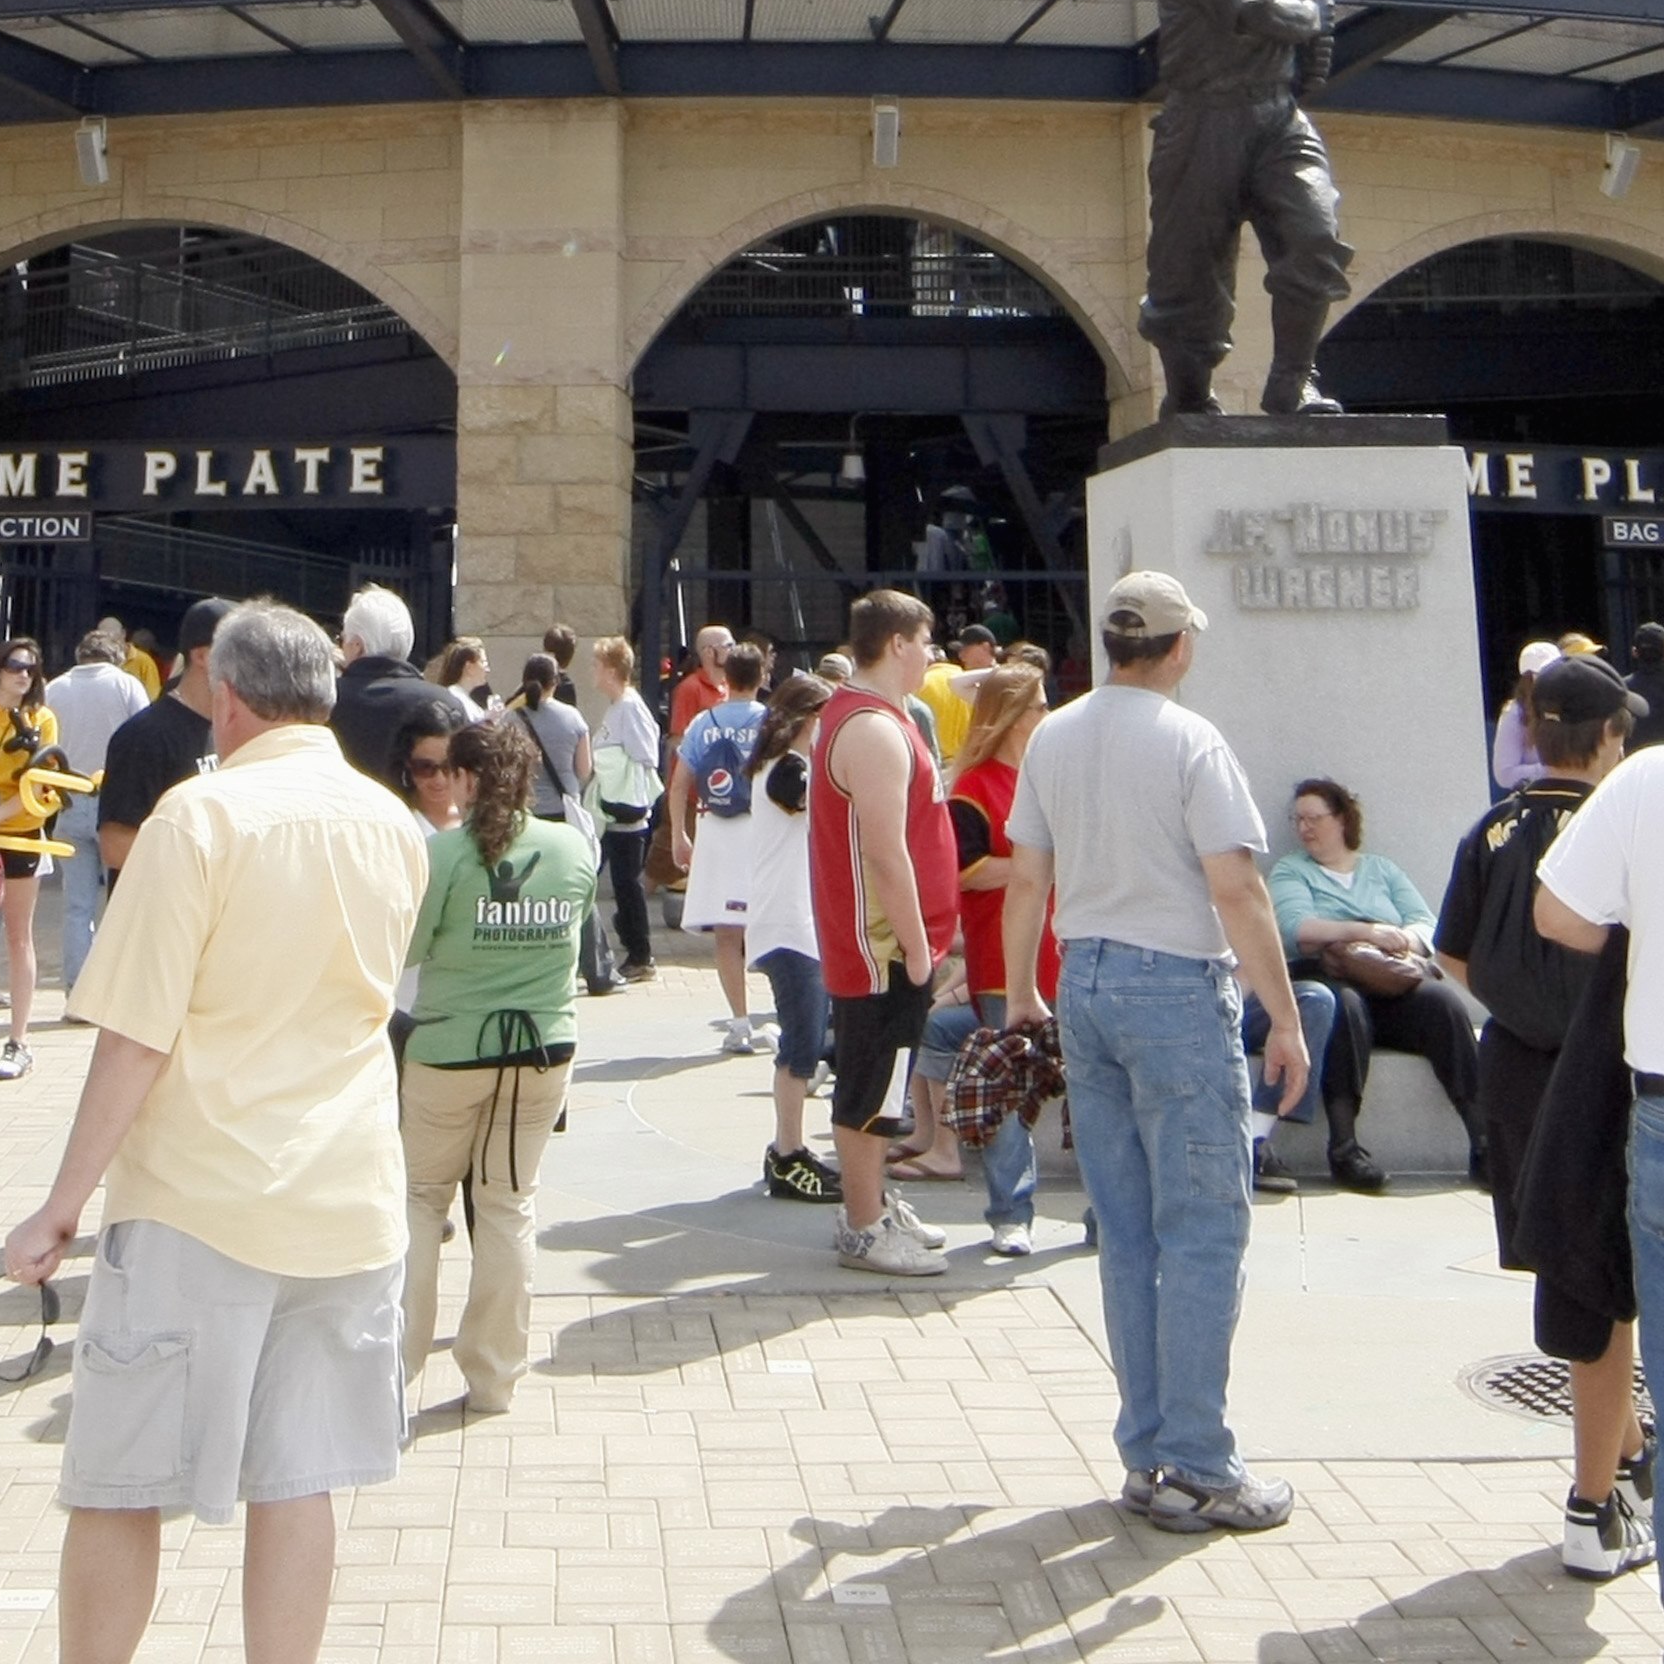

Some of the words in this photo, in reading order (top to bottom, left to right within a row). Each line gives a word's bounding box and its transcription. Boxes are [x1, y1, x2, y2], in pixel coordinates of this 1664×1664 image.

[142, 445, 386, 497] PLATE
[1613, 522, 1660, 543] BAG
[1235, 564, 1420, 610] WAGNER
[476, 895, 572, 926] fanfoto
[473, 927, 571, 942] PHOTOGRAPHE
